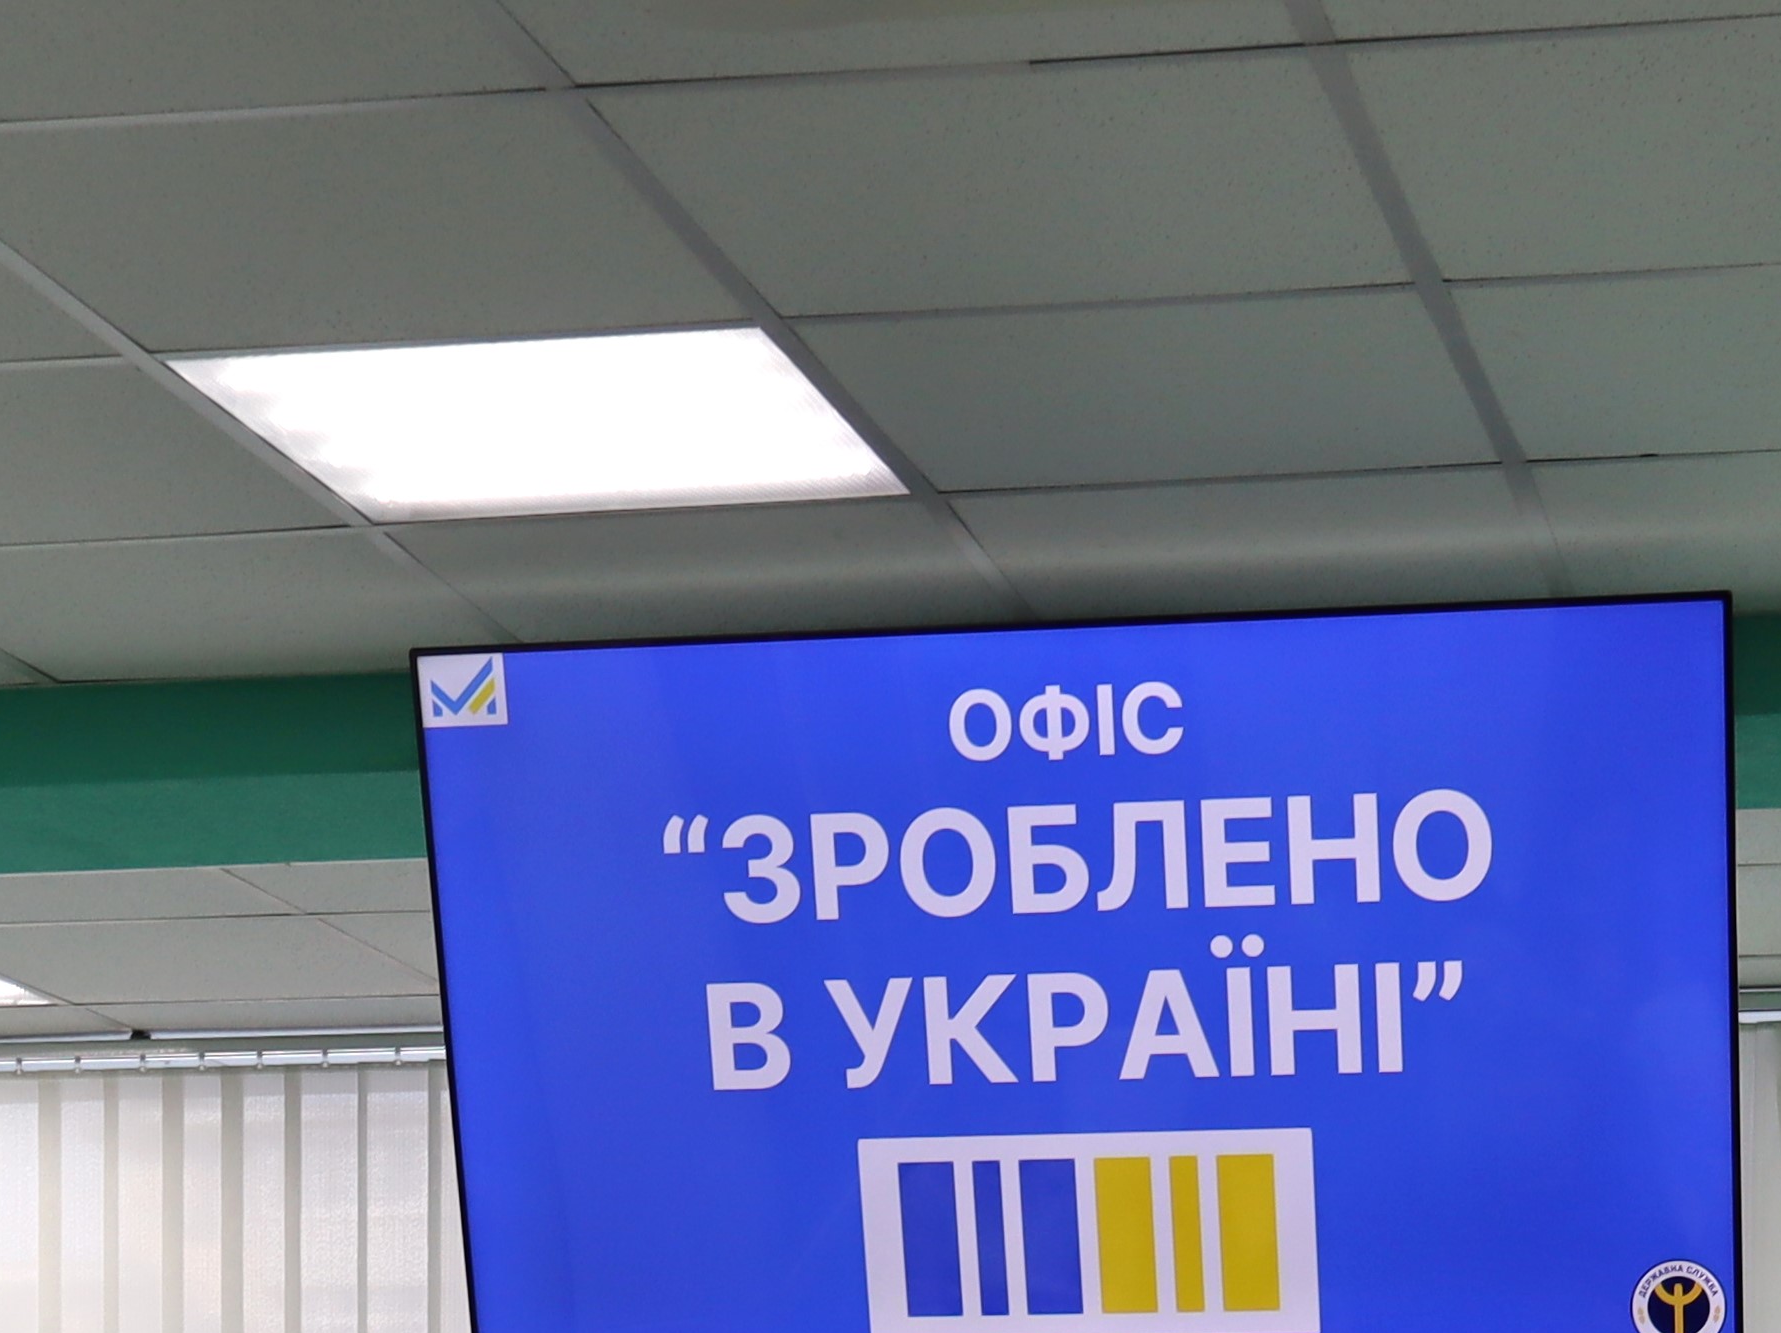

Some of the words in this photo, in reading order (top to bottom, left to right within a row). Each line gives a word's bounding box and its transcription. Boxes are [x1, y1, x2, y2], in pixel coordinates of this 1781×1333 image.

[948, 681, 1185, 762] ОФІС
[662, 788, 1493, 924] “ЗРОБЛЕНО
[705, 982, 792, 1091] В
[823, 935, 1464, 1090] УКРАЇНІ”
[1638, 1264, 1684, 1298] ДЕРЖАВНА
[1686, 1265, 1719, 1298] СЛУЖБА
